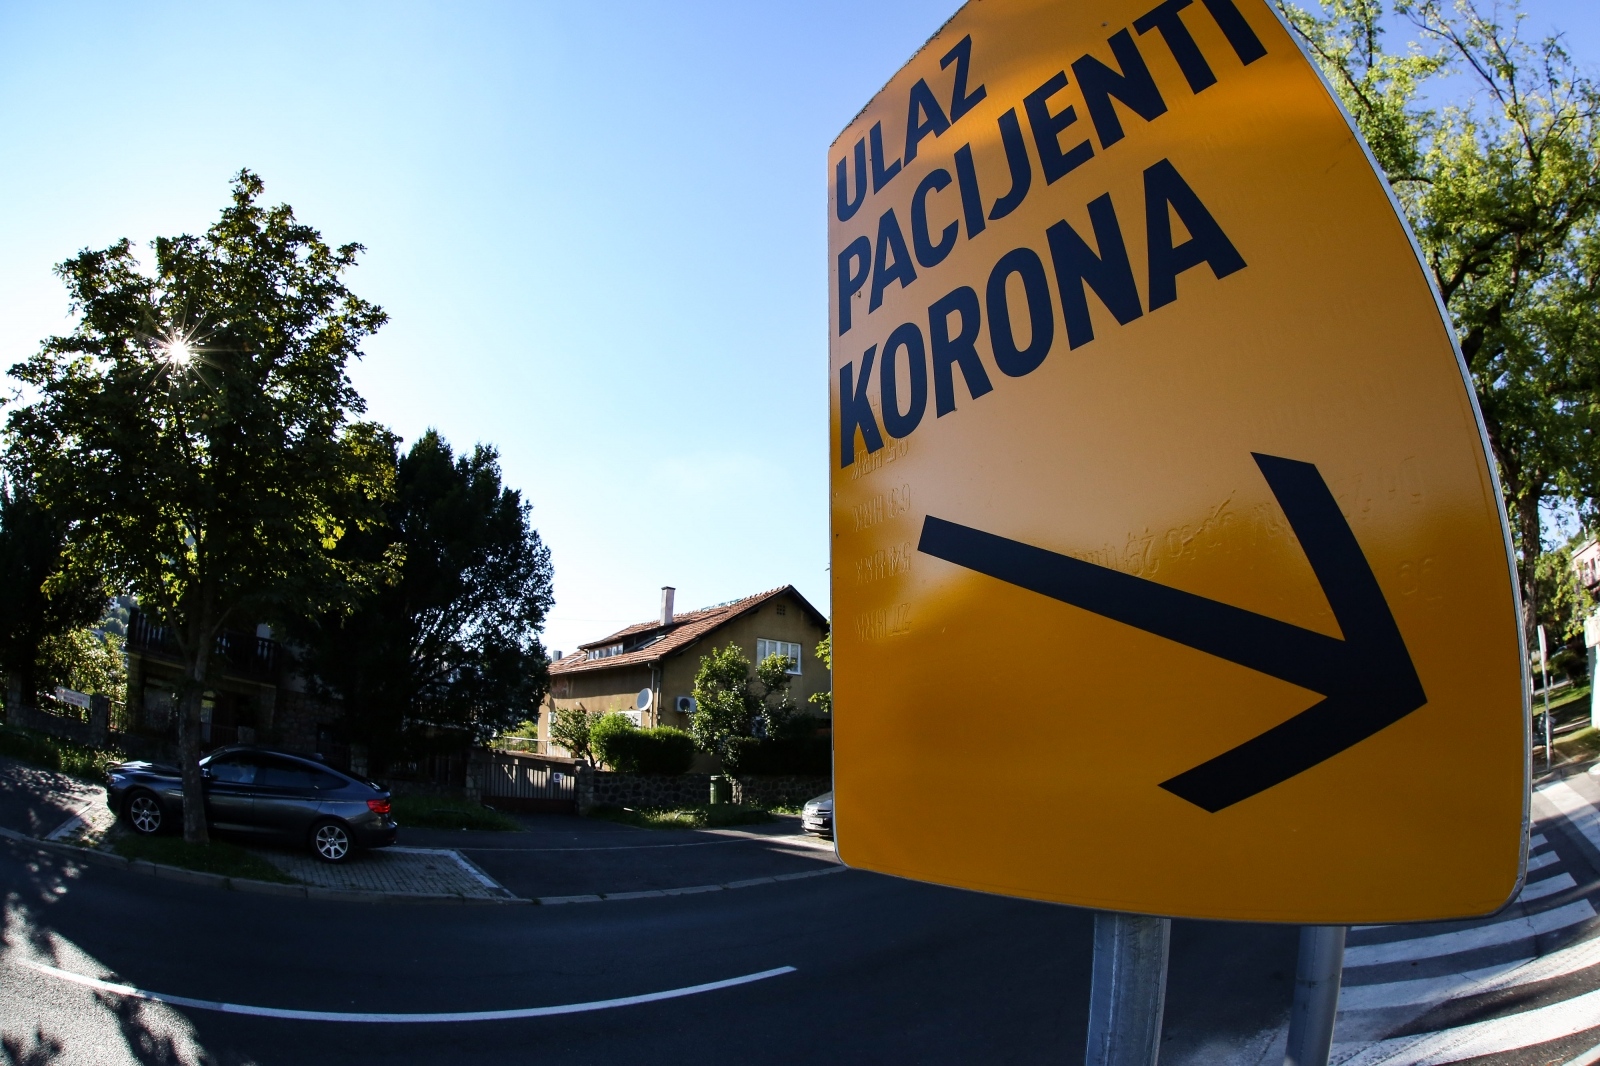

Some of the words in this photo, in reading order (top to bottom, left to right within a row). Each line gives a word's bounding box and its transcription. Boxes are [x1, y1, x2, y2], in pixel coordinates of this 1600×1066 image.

[836, 34, 987, 222] ULAZ
[838, 0, 1268, 337] PACIJENTI
[839, 157, 1248, 469] KORONA
